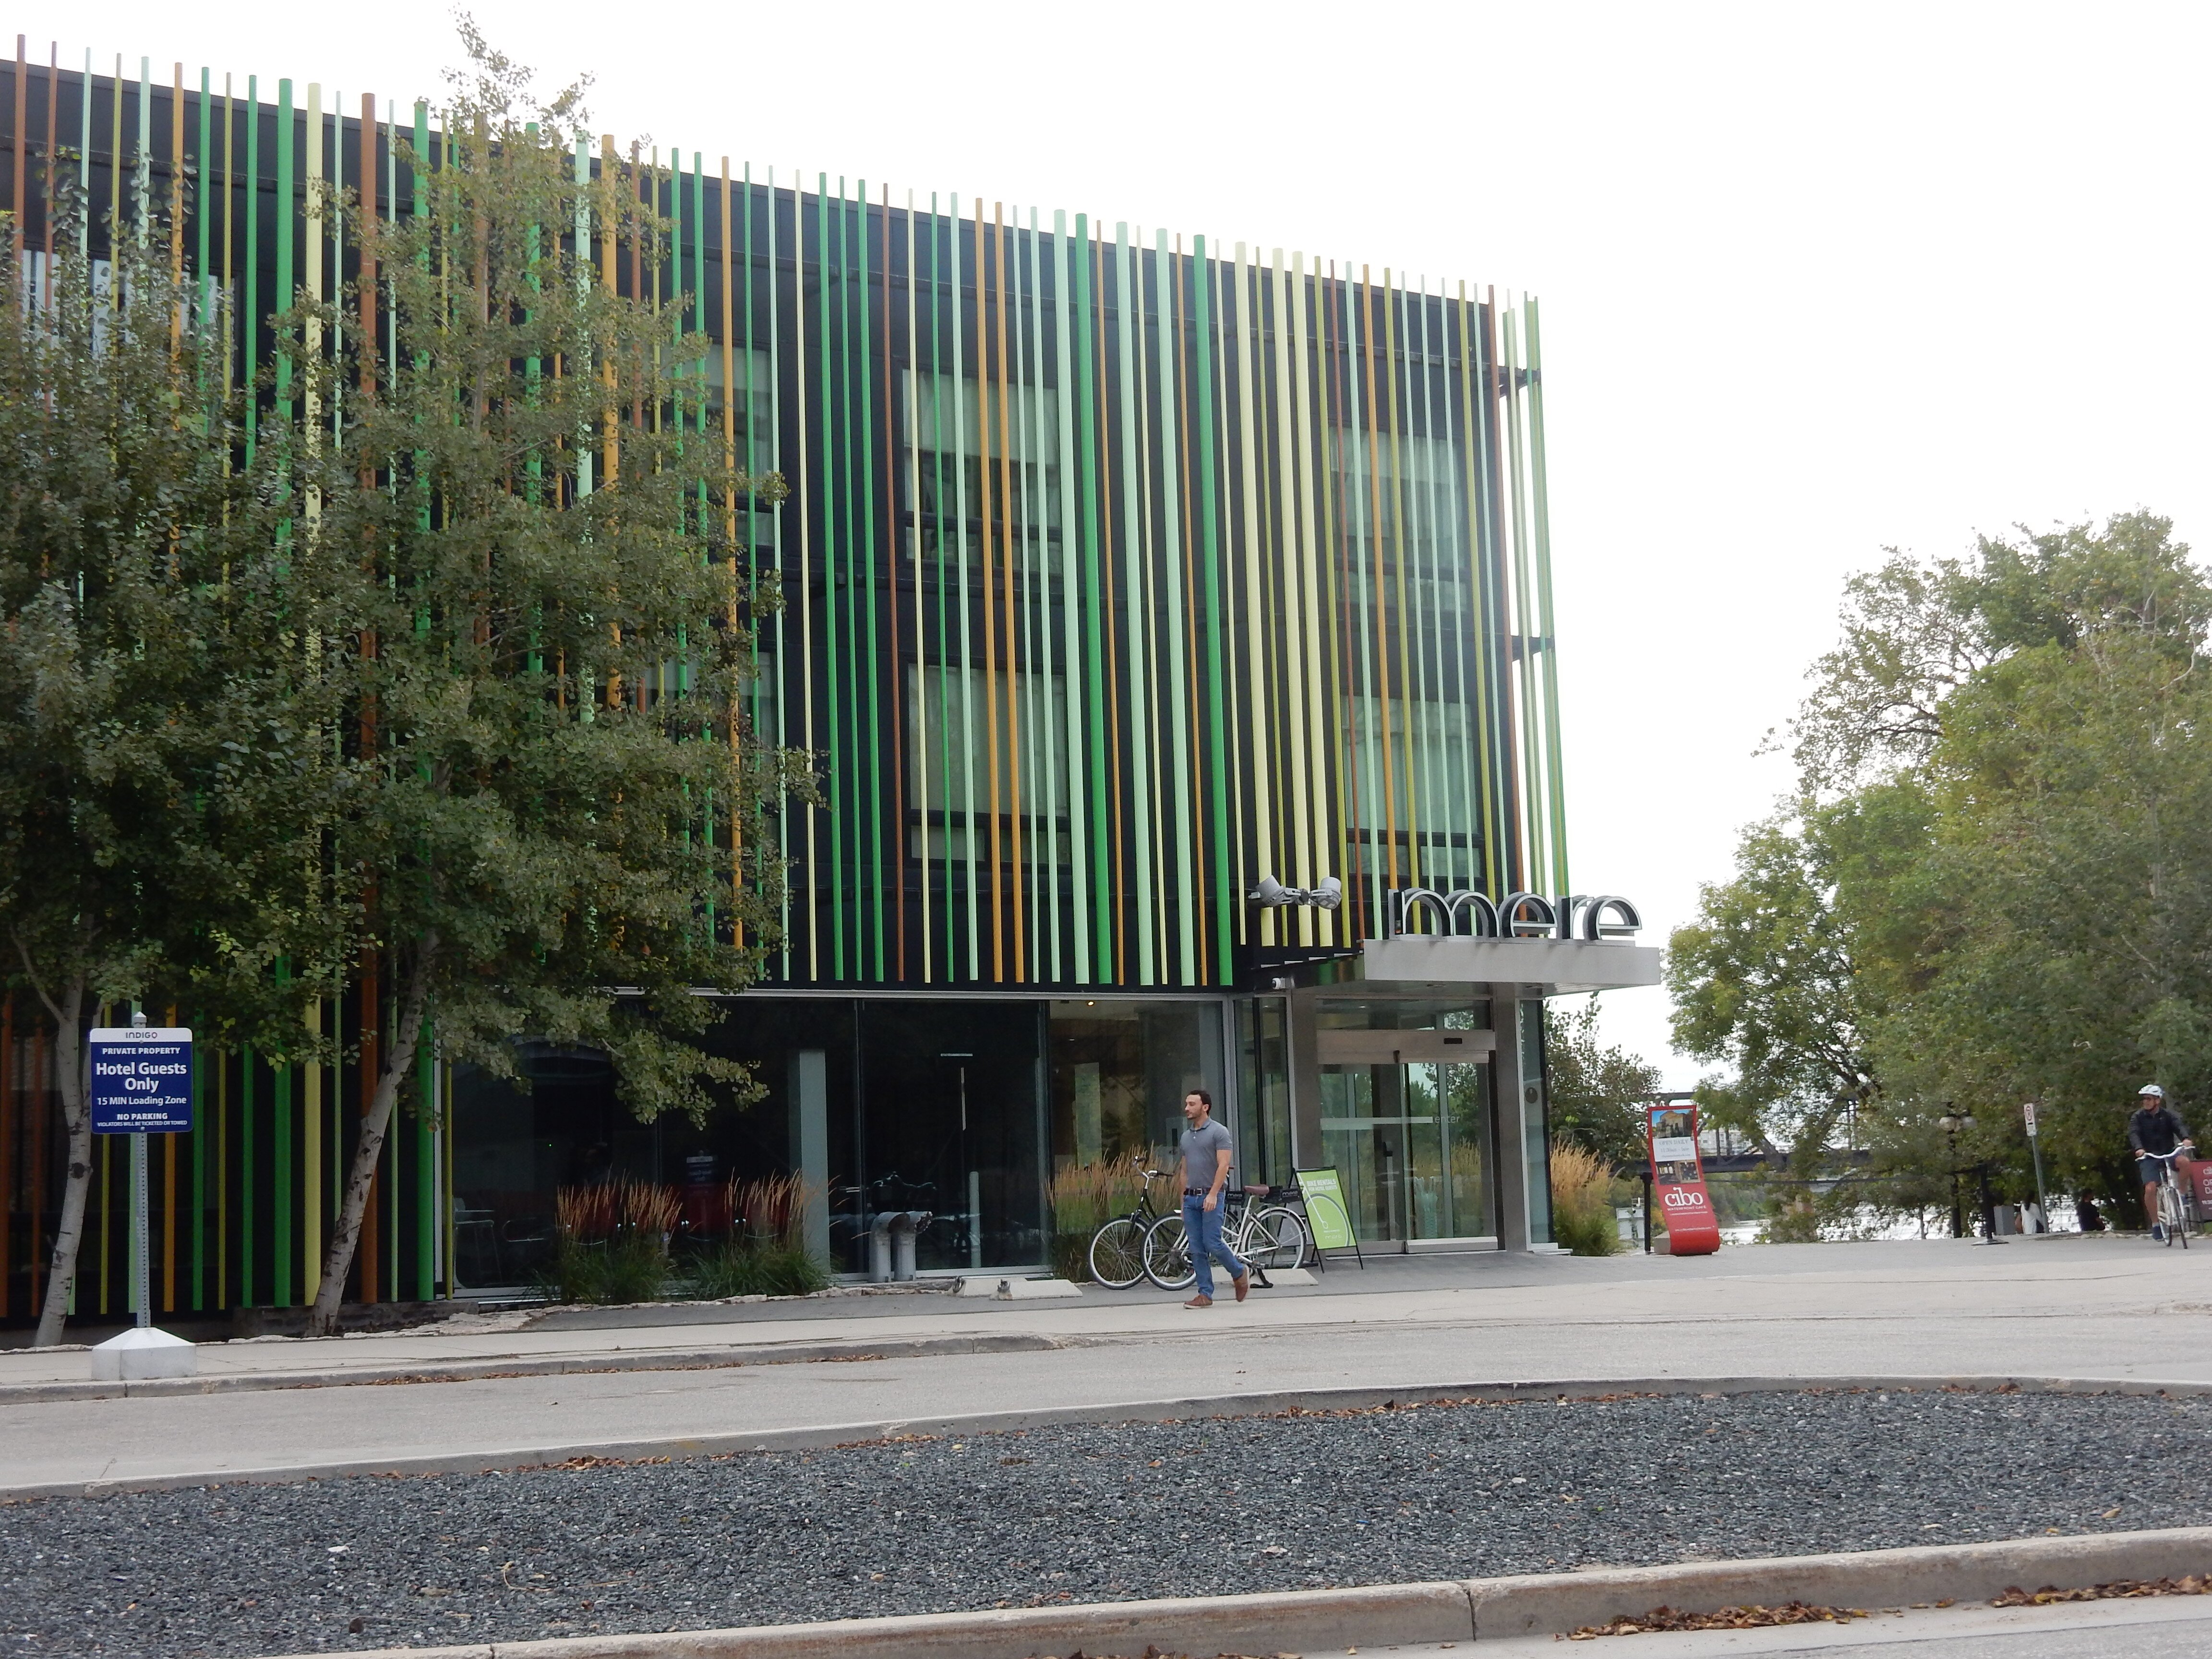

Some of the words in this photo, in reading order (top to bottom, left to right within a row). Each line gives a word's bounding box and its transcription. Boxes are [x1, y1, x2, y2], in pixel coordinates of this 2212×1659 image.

[1388, 888, 1642, 941] mere
[96, 1062, 135, 1075] Hotel
[139, 1063, 187, 1075] Guests
[125, 1077, 159, 1093] Only
[129, 1096, 163, 1106] Loading
[165, 1096, 187, 1104] Zone
[1435, 1115, 1460, 1123] enter
[1664, 1187, 1703, 1206] cibo
